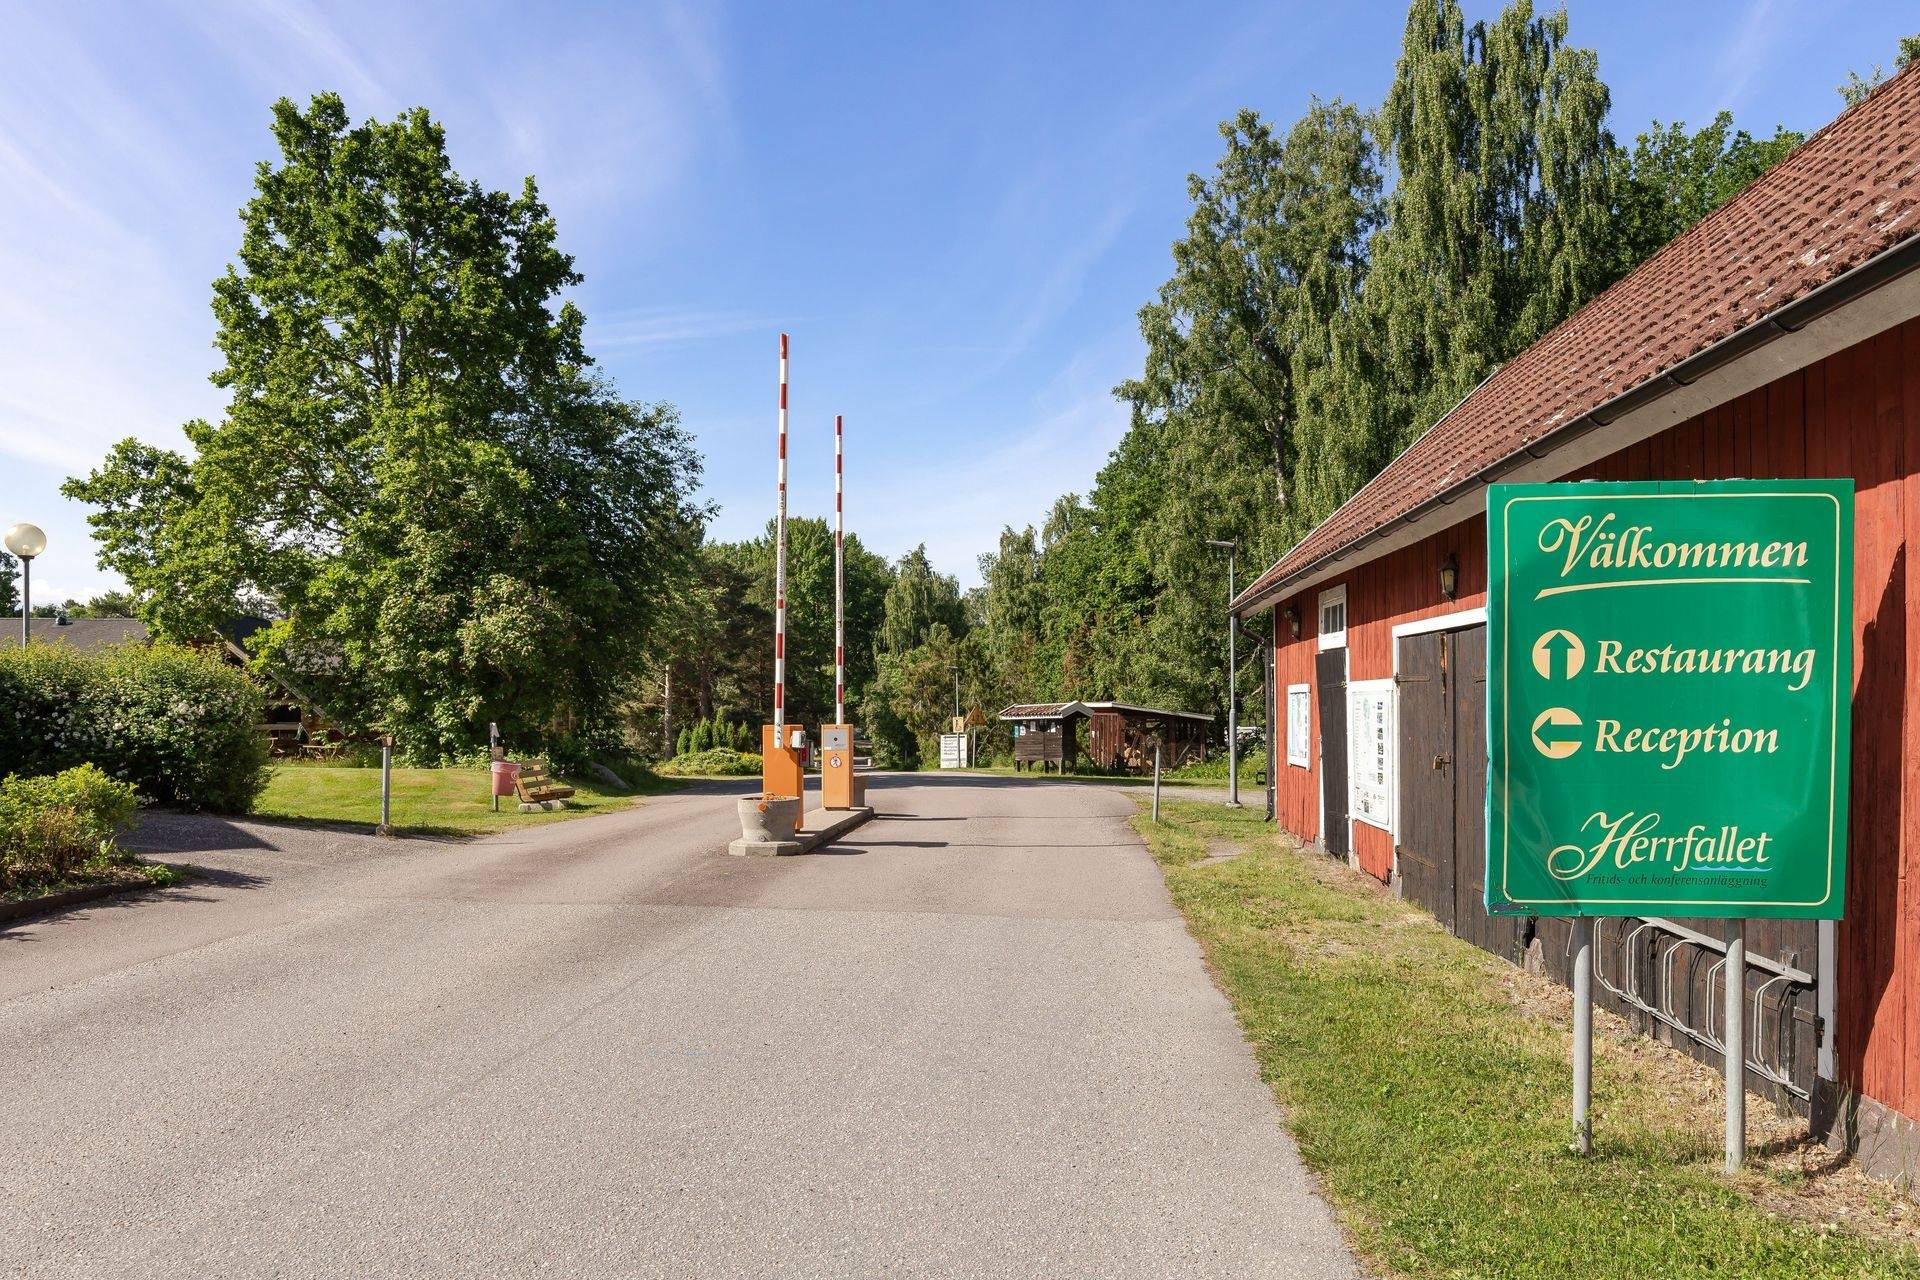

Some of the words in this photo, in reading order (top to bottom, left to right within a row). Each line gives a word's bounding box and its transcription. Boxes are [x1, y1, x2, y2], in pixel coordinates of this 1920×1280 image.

[1538, 512, 1809, 578] Välkommen
[1594, 640, 1816, 691] Restaurang
[1594, 718, 1779, 770] Reception
[1548, 811, 1773, 880] Herrfallet
[1586, 873, 1624, 885] Fritids-
[1628, 873, 1647, 885] och
[1651, 873, 1768, 888] konferensanläggning
